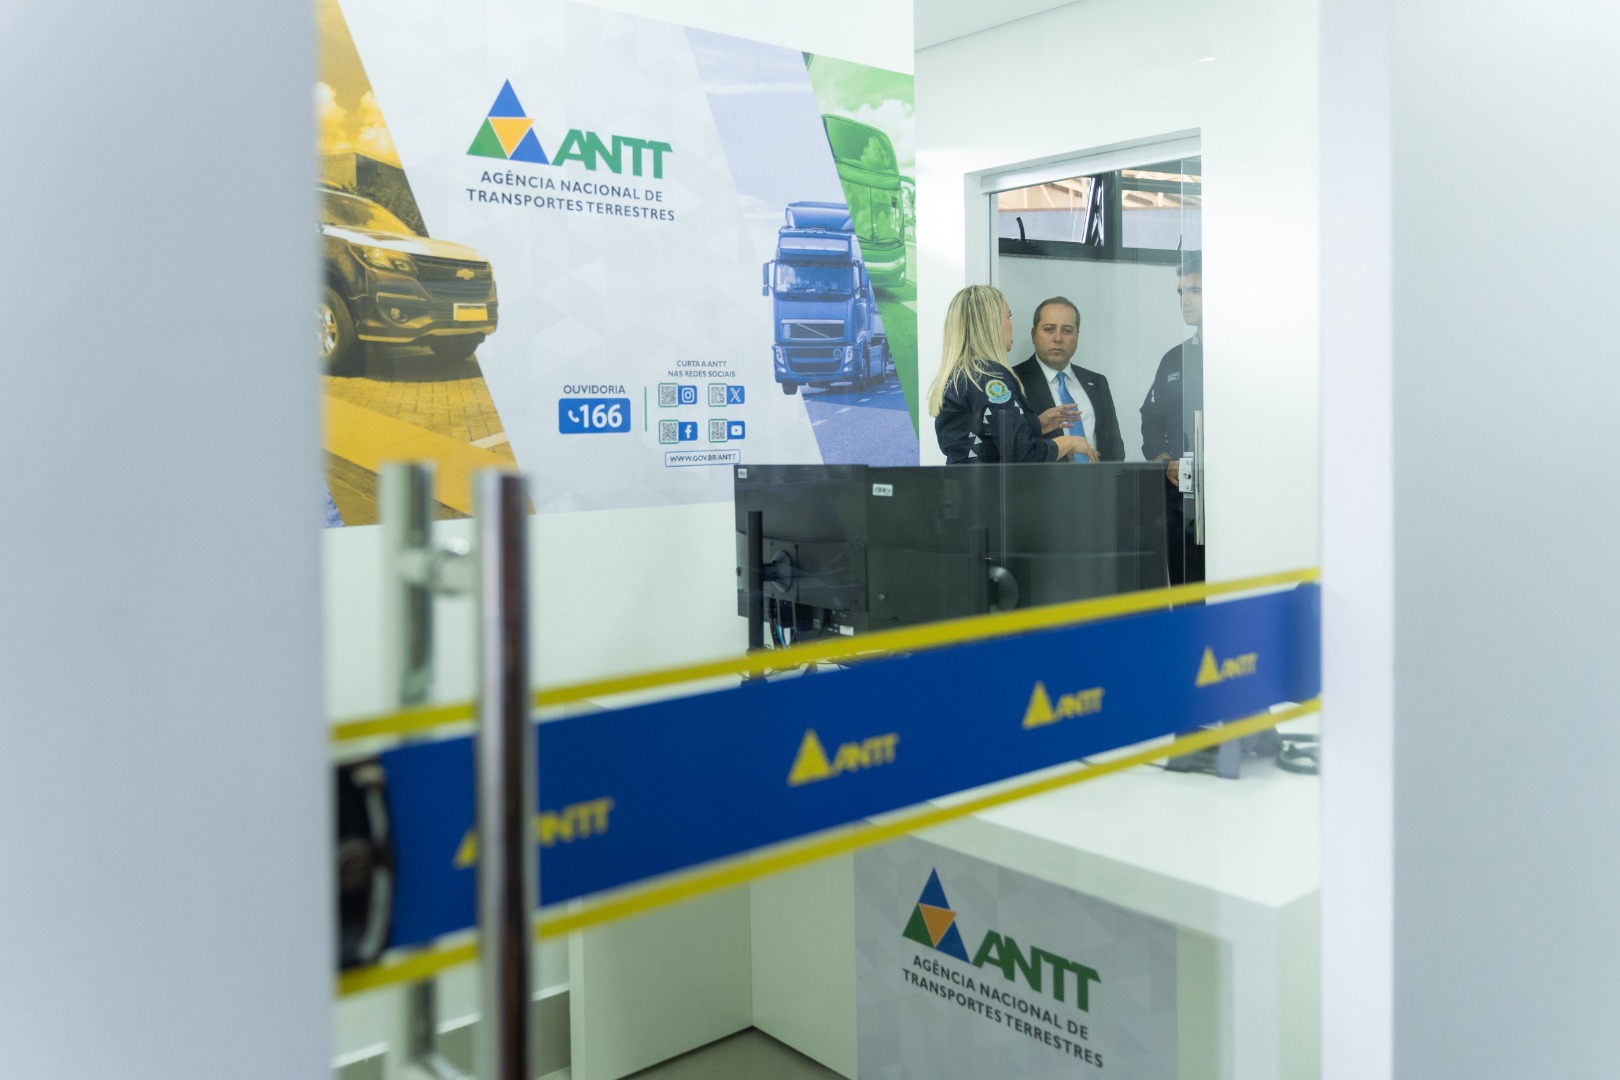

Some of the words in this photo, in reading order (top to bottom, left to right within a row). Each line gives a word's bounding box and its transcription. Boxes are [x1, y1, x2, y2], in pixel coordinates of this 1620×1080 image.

[551, 128, 673, 179] ANTT
[480, 169, 556, 191] AGÊNCIA
[560, 180, 640, 200] NACIONAL
[644, 190, 663, 202] DE
[466, 188, 583, 212] TRANSPORTES
[586, 201, 675, 221] TERRESTRES
[667, 370, 684, 378] NAS
[684, 370, 707, 378] REDES
[707, 370, 736, 378] SOCIAIS
[676, 360, 700, 368] CURTA
[701, 360, 707, 368] A
[707, 360, 727, 368] ANTT
[563, 384, 626, 395] OUVIDORIA
[579, 404, 623, 428] 166
[1220, 652, 1258, 679] ANTT
[1054, 687, 1105, 721] ANTT
[829, 732, 900, 777] ANTT
[537, 797, 615, 848] NTT
[971, 929, 1102, 1013] ANTT
[913, 954, 976, 992] AGÊNCIA
[980, 982, 1062, 1029] NACIONAL
[1067, 1019, 1089, 1041] DE
[902, 968, 1002, 1023] TRANSPORTES
[1004, 1012, 1104, 1069] TERRESTRES
